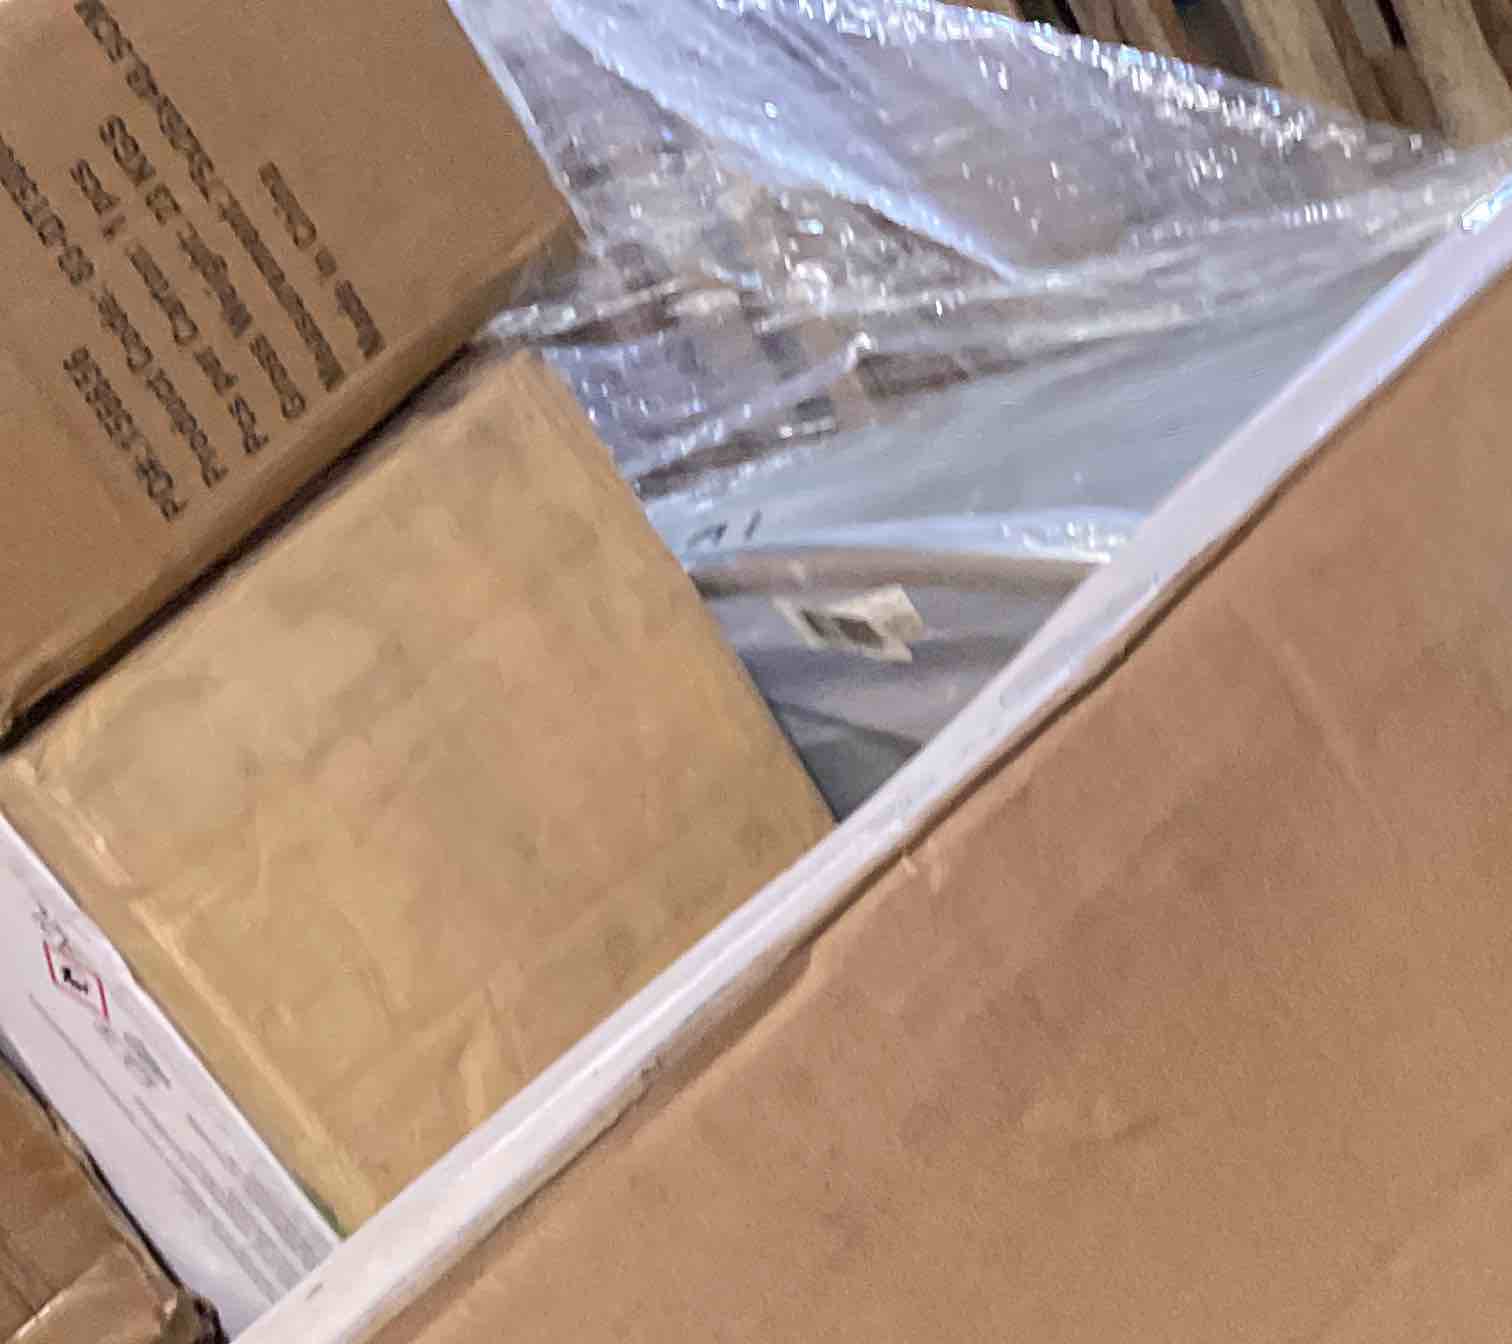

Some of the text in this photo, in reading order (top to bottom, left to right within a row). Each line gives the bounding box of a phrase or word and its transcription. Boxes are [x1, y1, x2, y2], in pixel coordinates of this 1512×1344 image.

[68, 157, 121, 217] pcs
[97, 114, 157, 188] KGS
[257, 160, 386, 361] Made in China
[191, 344, 239, 397] per
[247, 332, 307, 421] Gross
[144, 366, 229, 489] Product
[226, 393, 270, 456] Pcs
